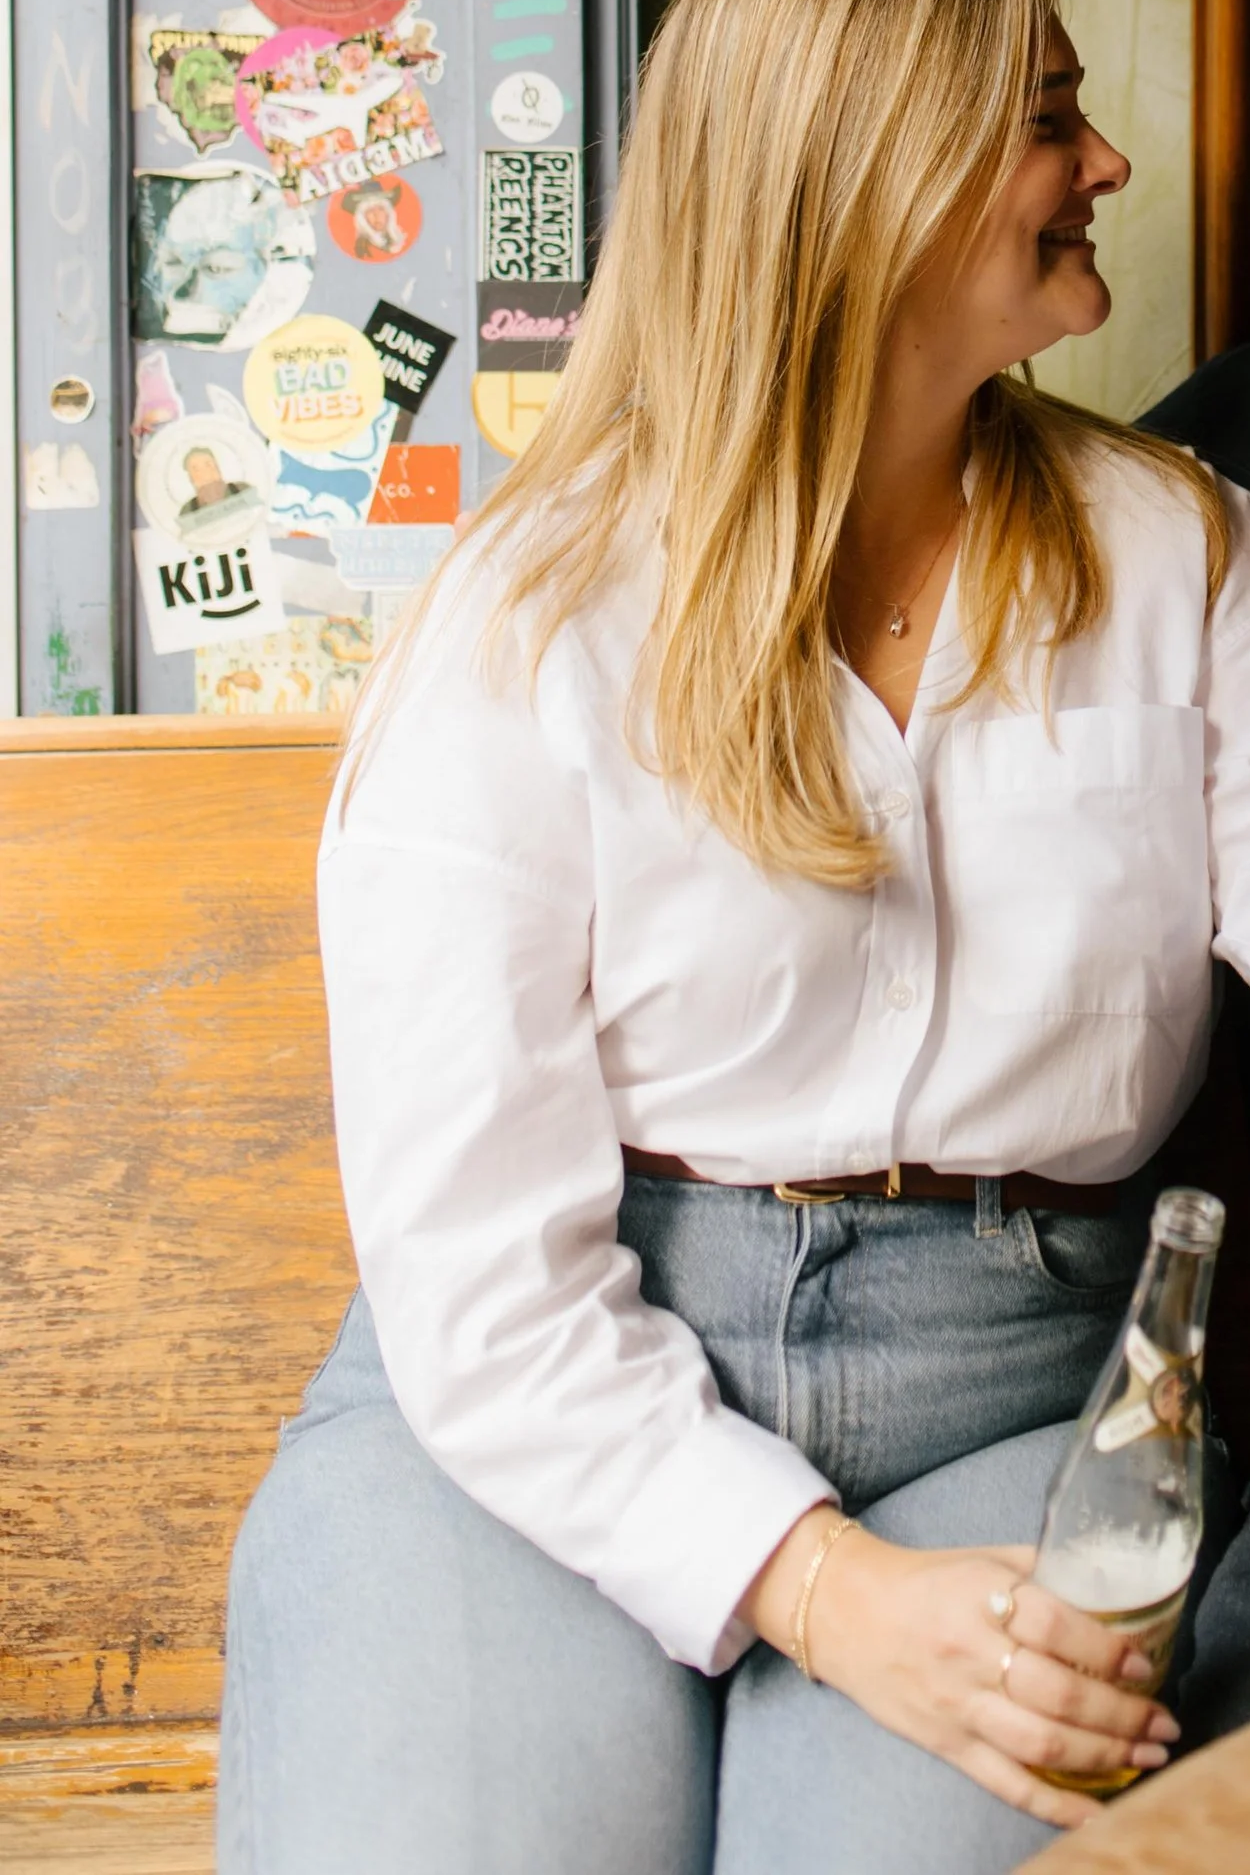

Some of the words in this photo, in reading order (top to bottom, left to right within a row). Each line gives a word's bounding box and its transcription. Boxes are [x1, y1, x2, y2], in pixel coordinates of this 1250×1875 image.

[536, 154, 571, 280] PHANTOM
[372, 321, 437, 367] JUNE
[276, 358, 351, 396] BAD
[377, 348, 428, 394] HINE
[268, 392, 365, 423] VIBES
